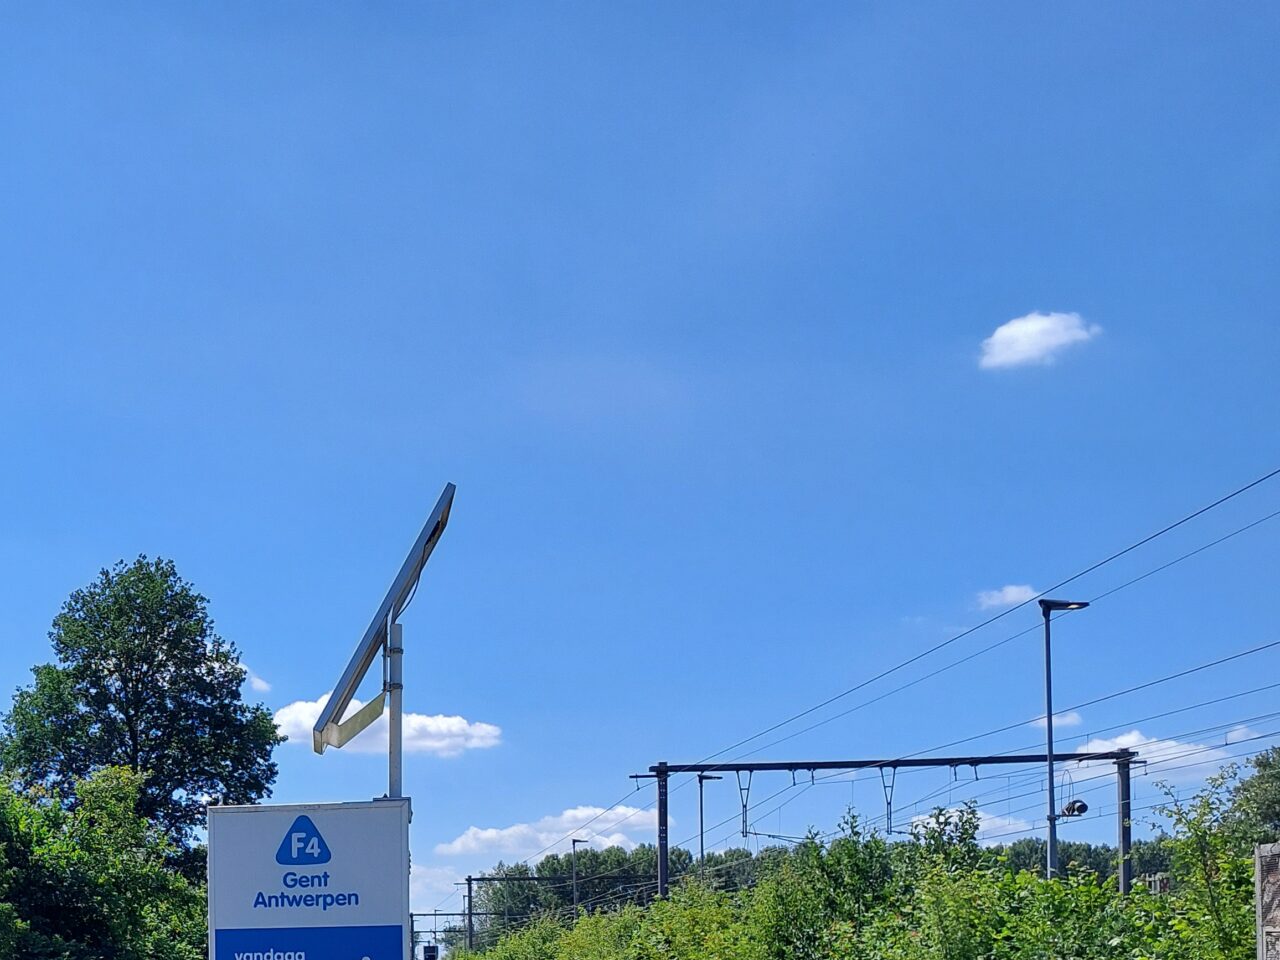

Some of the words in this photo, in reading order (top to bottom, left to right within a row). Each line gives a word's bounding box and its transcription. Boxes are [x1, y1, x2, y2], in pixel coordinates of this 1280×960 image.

[291, 832, 321, 859] F4
[283, 871, 330, 888] Gent
[253, 891, 359, 911] Antwerpen
